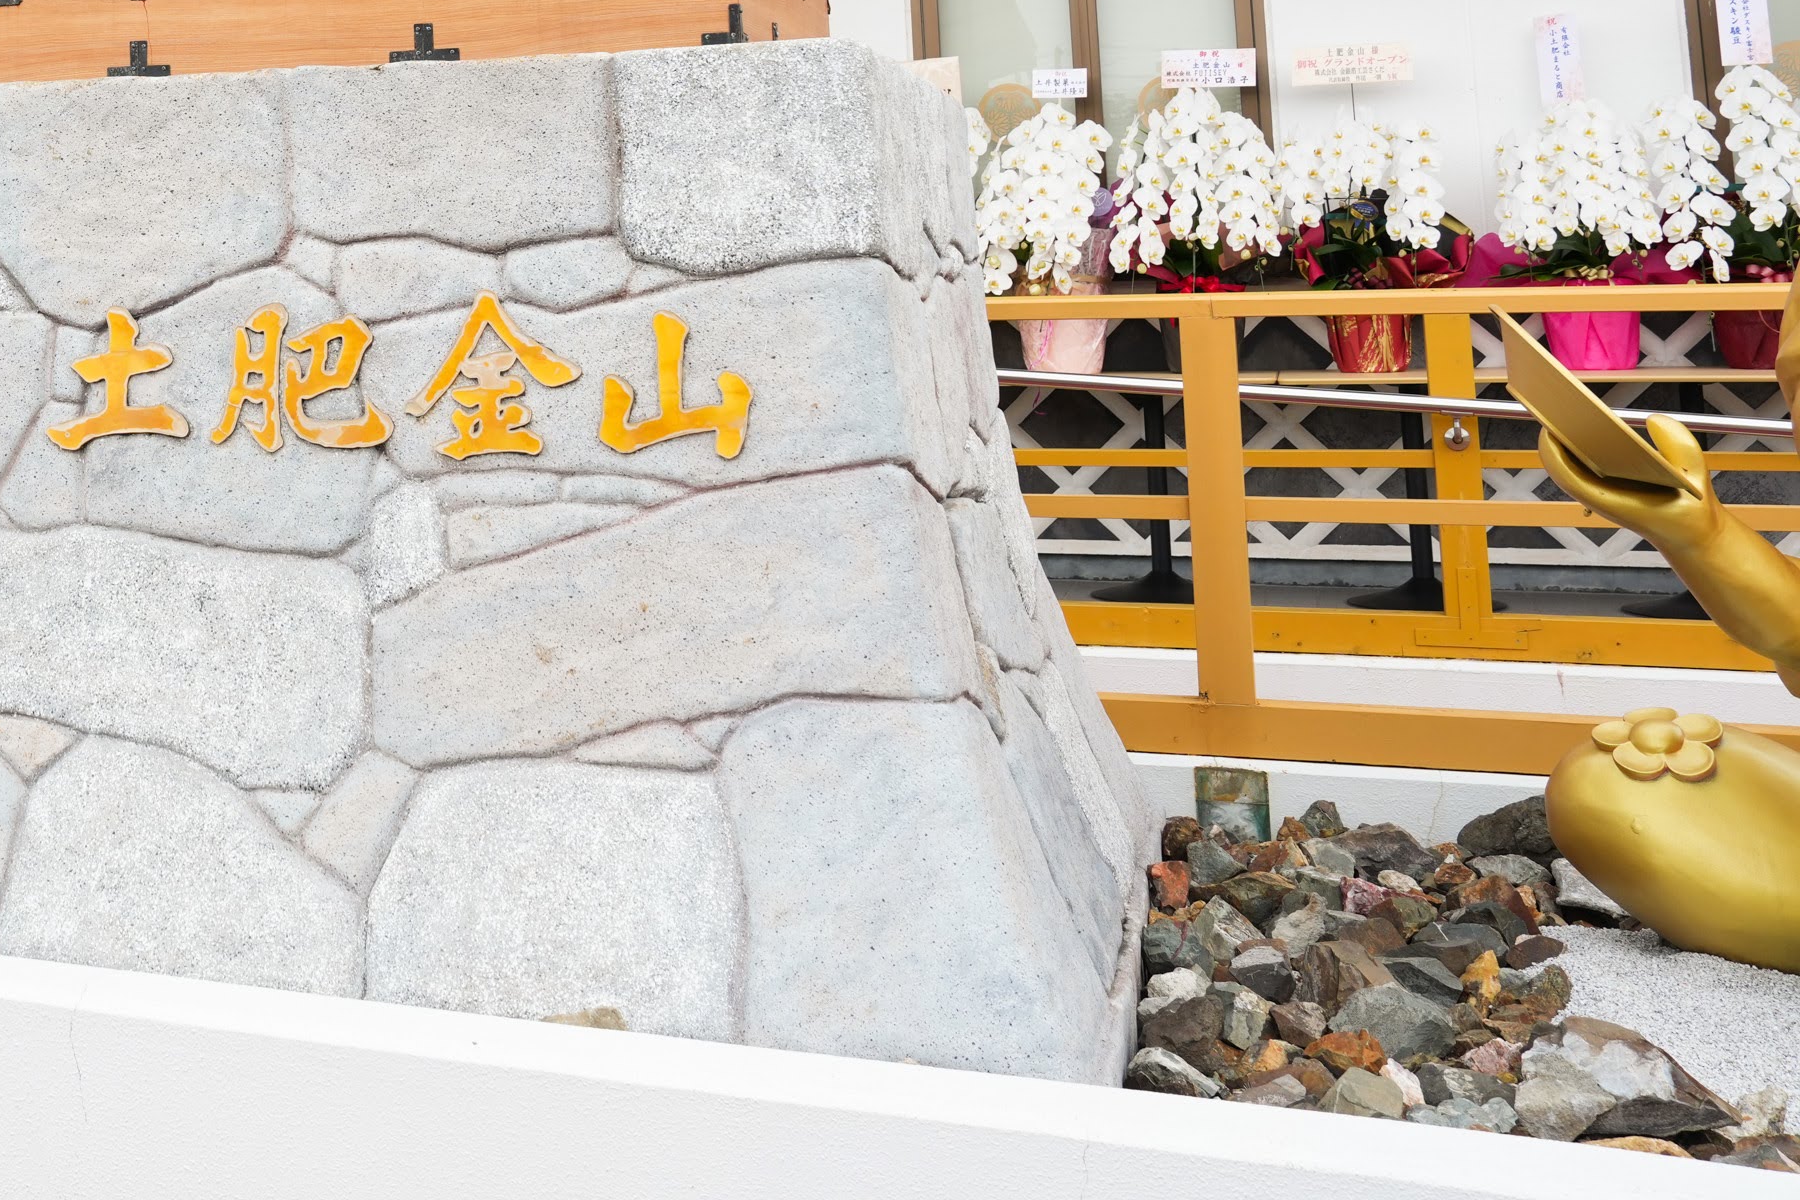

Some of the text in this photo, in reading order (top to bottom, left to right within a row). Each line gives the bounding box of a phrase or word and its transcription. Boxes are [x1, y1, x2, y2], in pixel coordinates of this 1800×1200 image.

[1547, 17, 1557, 26] 祝
[1561, 26, 1571, 56] 有限会社
[1199, 50, 1220, 58] 御祝
[1328, 45, 1379, 57] 土肥金山 様
[1192, 61, 1231, 69] 土肥金山
[1297, 55, 1408, 69] 御祝 グランドオープン
[1315, 68, 1337, 76] 株式会社
[46, 289, 754, 460] 土肥金山
